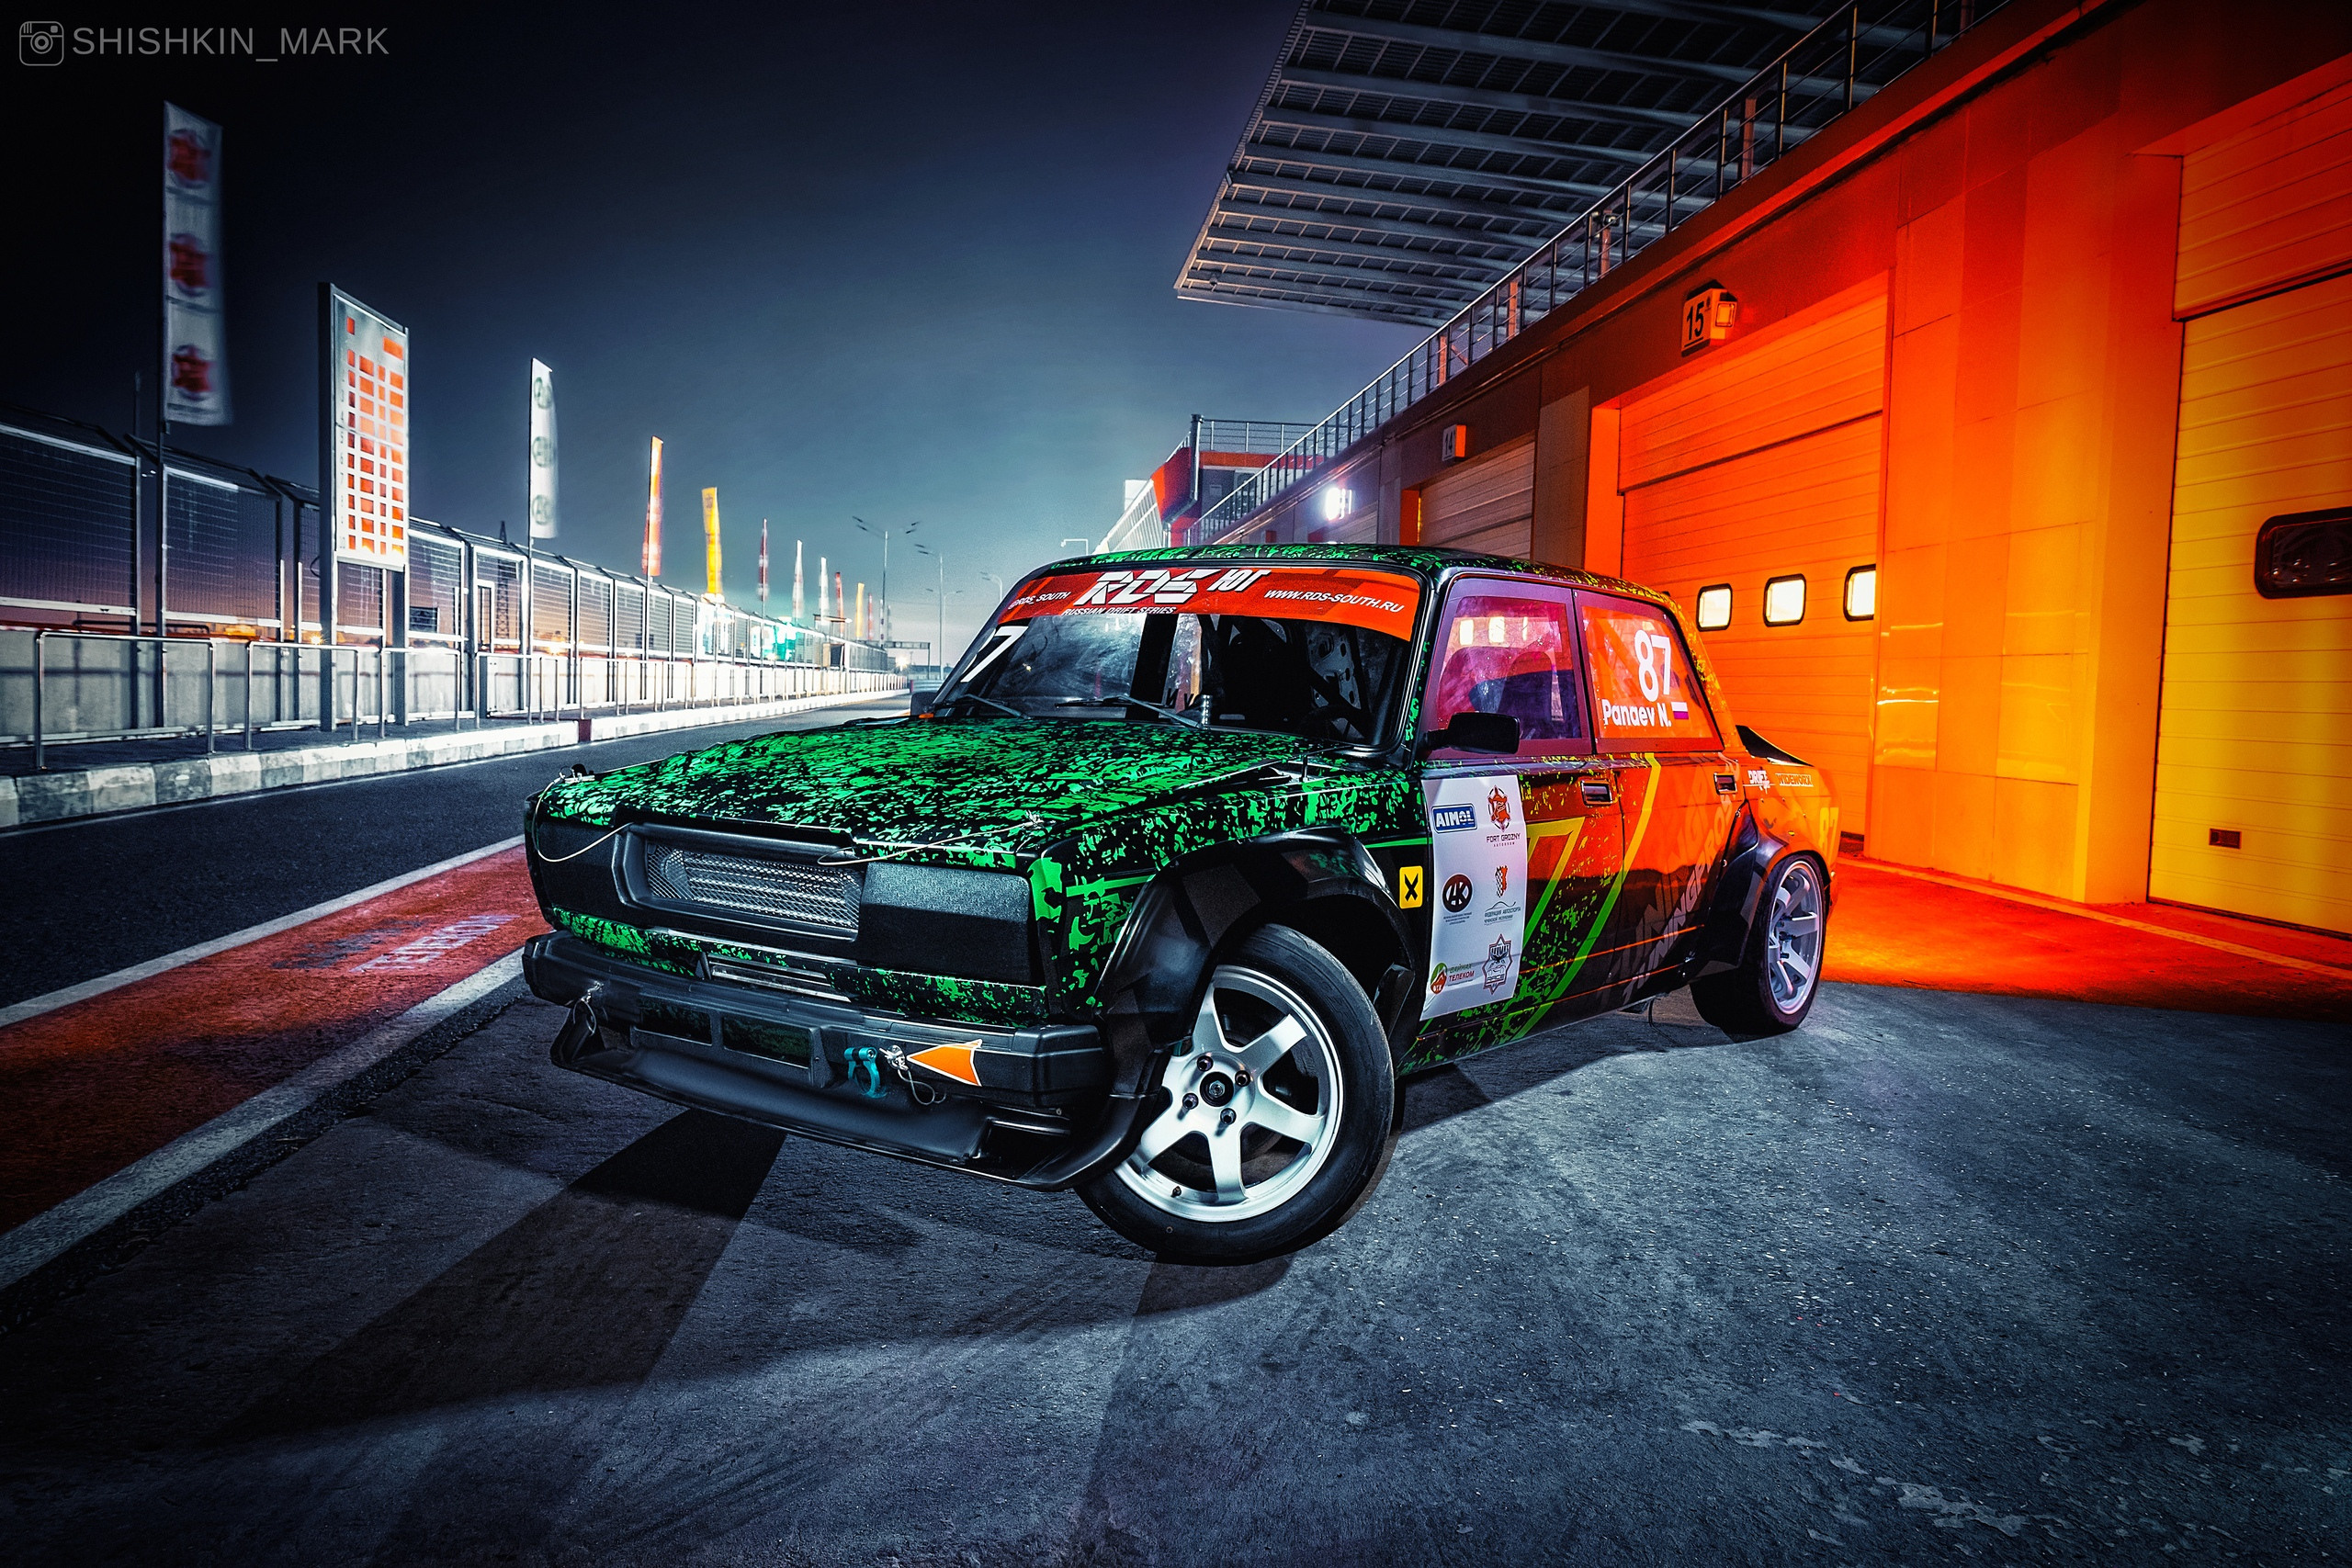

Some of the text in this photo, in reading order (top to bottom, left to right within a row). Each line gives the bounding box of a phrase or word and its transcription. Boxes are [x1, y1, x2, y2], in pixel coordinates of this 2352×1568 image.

[1687, 300, 1704, 341] 15
[1445, 431, 1453, 456] 14
[1073, 569, 1221, 605] RDS
[1264, 590, 1405, 613] WWW.RDS-SOUTH.RU
[1634, 629, 1671, 702] 87
[1601, 699, 1672, 728] Panaev N.
[1436, 810, 1475, 828] AIMOL
[1486, 832, 1521, 843] FORT GROZNY
[1449, 970, 1475, 982] ТЕЛЕКОМ
